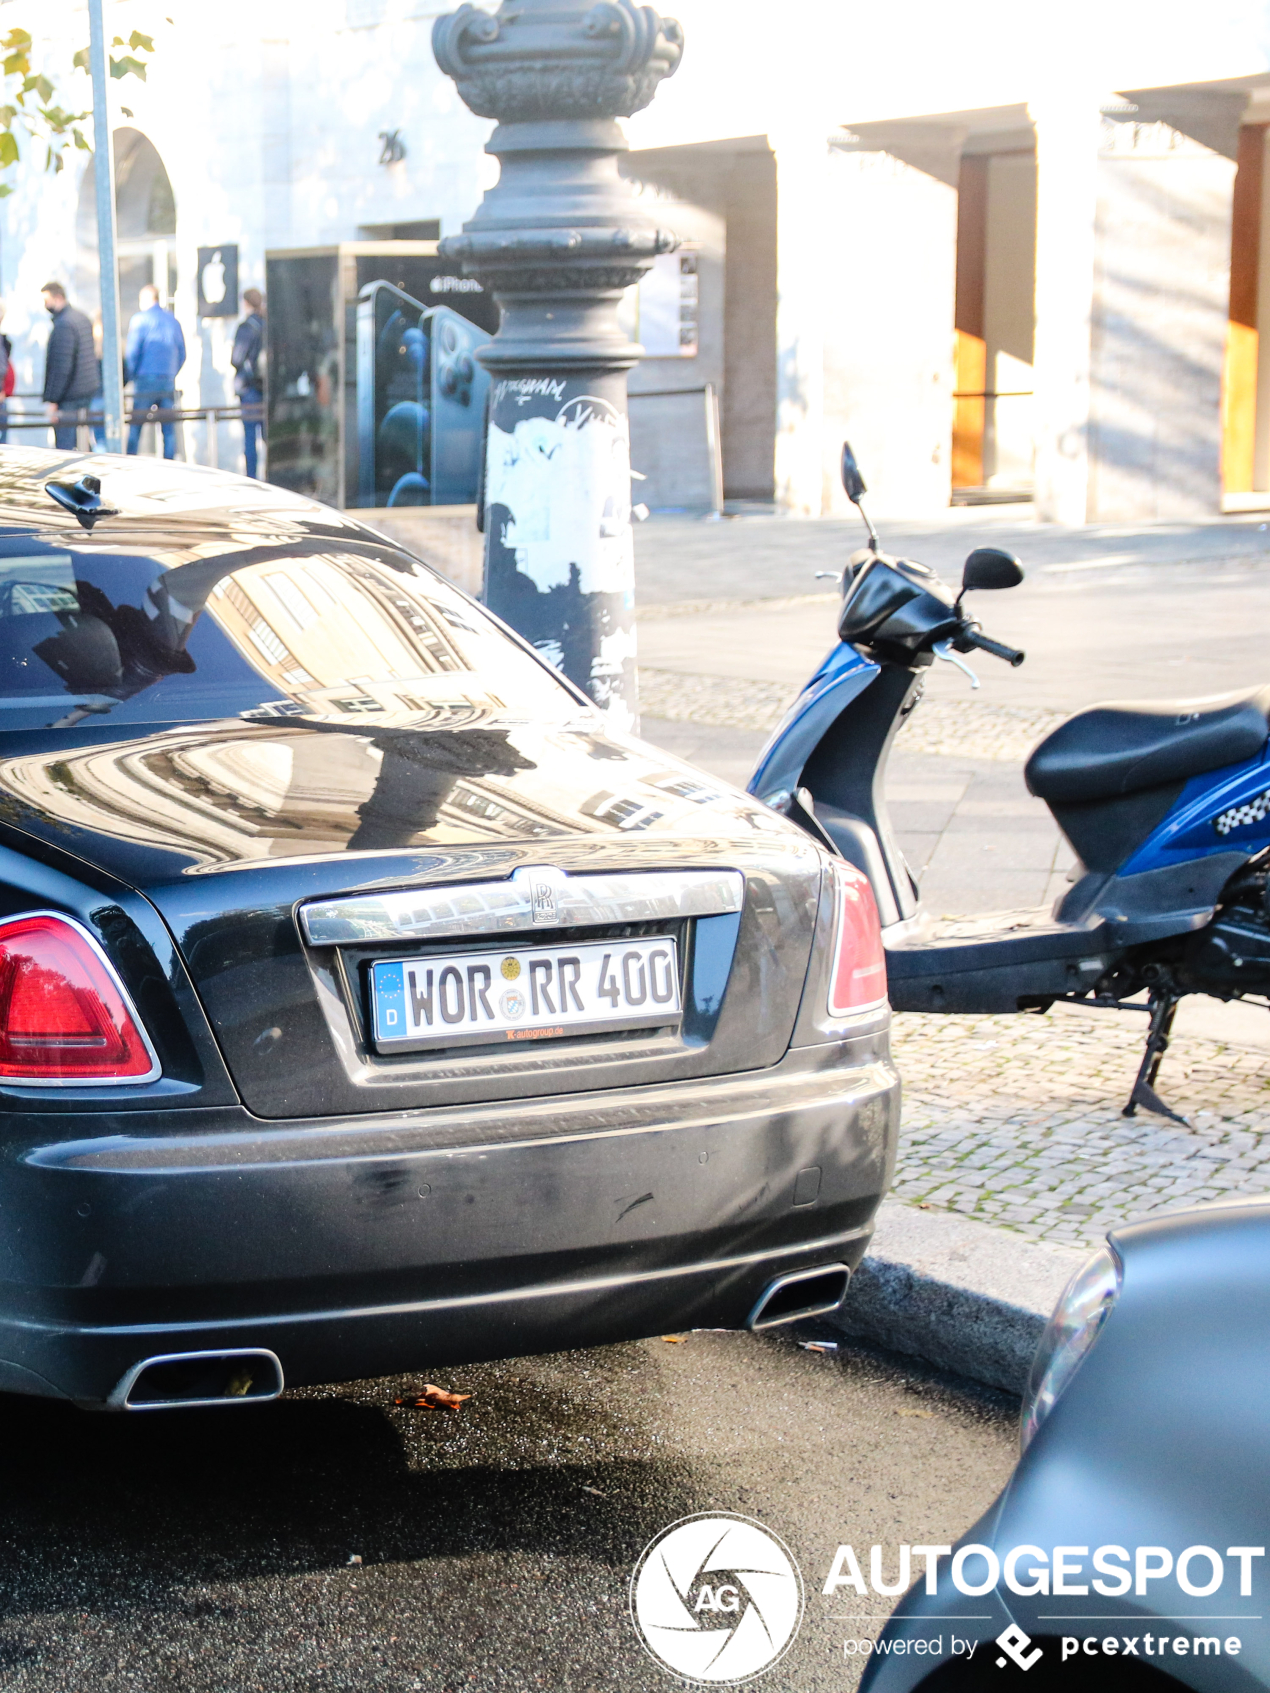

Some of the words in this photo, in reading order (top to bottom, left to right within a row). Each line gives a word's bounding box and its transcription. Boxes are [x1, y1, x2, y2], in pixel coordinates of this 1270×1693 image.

[378, 128, 407, 164] 26
[407, 964, 495, 1027] WOR
[529, 955, 585, 1015] RR
[598, 949, 674, 1008] 400
[386, 1008, 398, 1026] D
